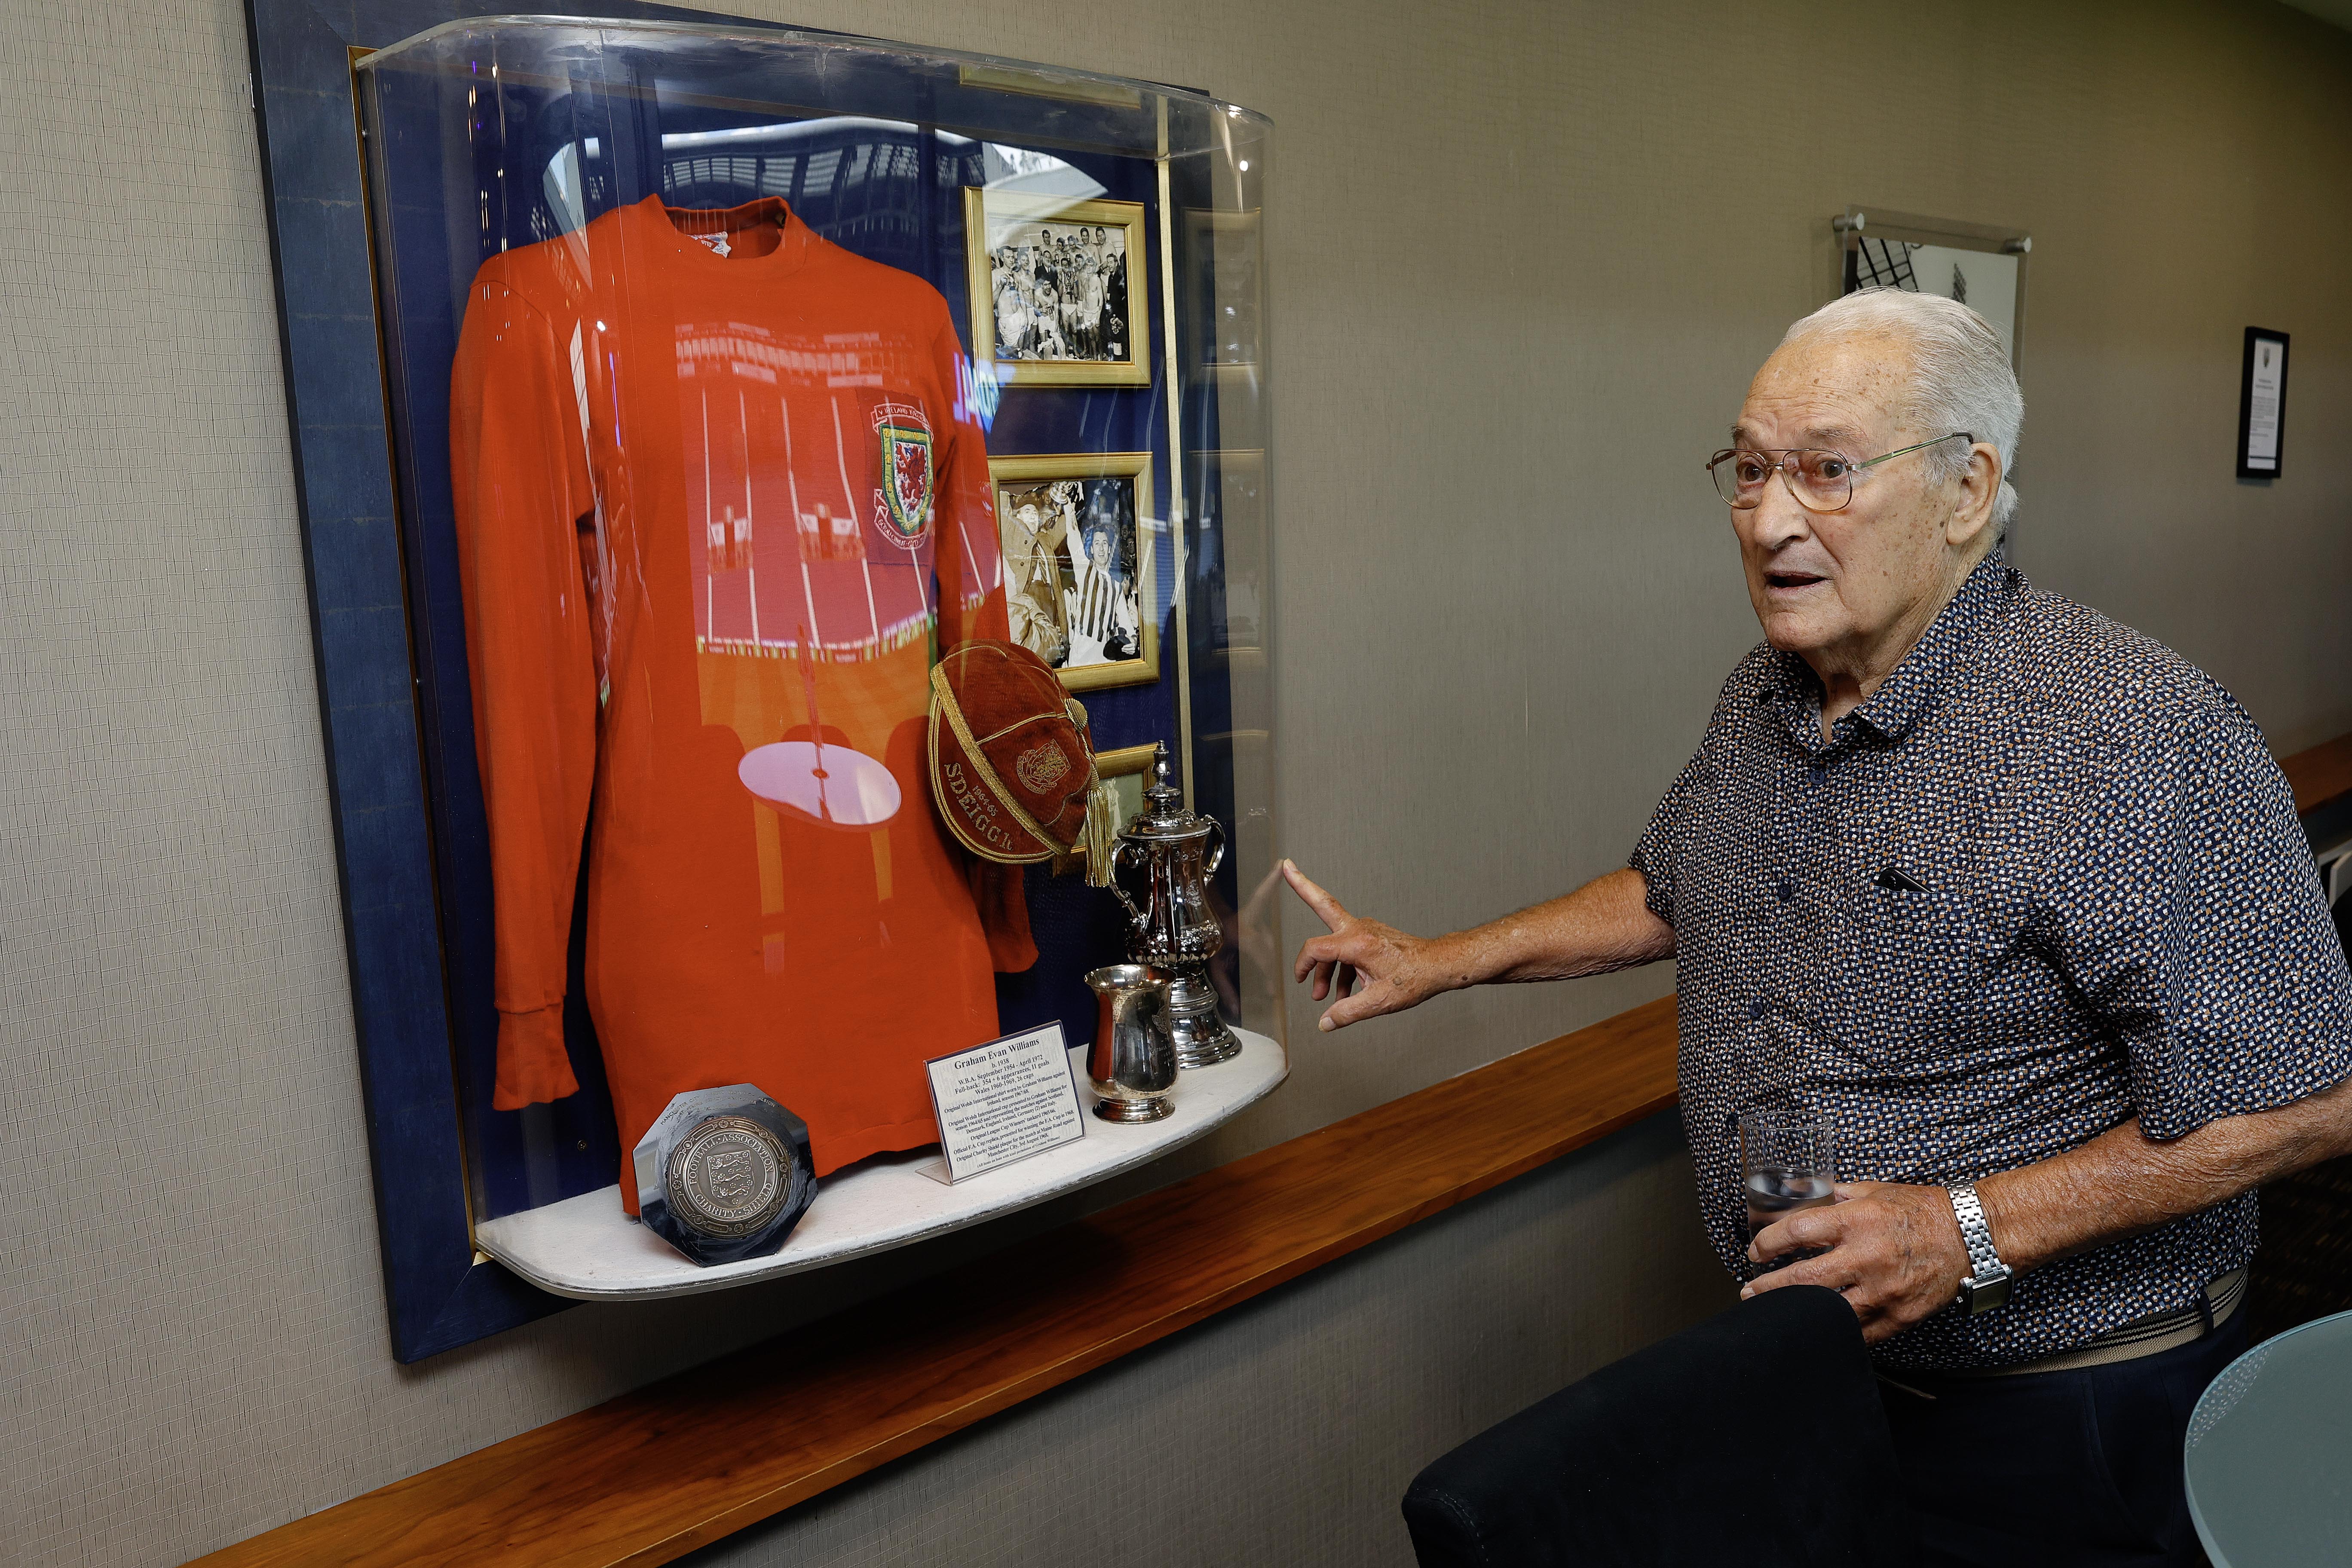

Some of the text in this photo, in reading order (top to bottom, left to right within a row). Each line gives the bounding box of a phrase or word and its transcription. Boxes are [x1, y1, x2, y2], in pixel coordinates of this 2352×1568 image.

[885, 407, 908, 415] IRELAND
[954, 1038, 1039, 1069] Graham Evan Williams
[997, 1057, 1009, 1066] 1938
[955, 1082, 980, 1094] Full-back:
[982, 1078, 991, 1086] 354
[1000, 1067, 1031, 1080] appearances,
[1037, 1060, 1050, 1069] goals
[958, 1076, 976, 1085] W.B.A.
[977, 1068, 1003, 1080] September
[1004, 1063, 1015, 1071] 1954
[1019, 1058, 1031, 1067] April
[1032, 1054, 1043, 1062] 1972
[990, 1078, 1017, 1090] 1960-1969,
[758, 1097, 776, 1107] ALBION
[944, 1104, 961, 1114] Original
[972, 1092, 997, 1104] International
[1022, 1080, 1037, 1088] Graham
[1053, 1070, 1065, 1078] against
[948, 1117, 965, 1127] Original
[977, 1105, 1001, 1118] International
[1008, 1097, 1027, 1108] presented
[1030, 1091, 1046, 1099] Graham
[968, 1118, 983, 1127] 1964/65
[991, 1109, 1014, 1120] representing
[1020, 1101, 1035, 1109] matches
[1035, 1096, 1048, 1105] against
[1017, 1108, 1034, 1117] Germany
[953, 1145, 968, 1155] Official
[999, 1129, 1017, 1140] presented
[956, 1152, 973, 1162] Original
[972, 1148, 987, 1156] Charity
[987, 1143, 1000, 1151] Shield
[999, 1139, 1012, 1148] plaque
[1062, 1117, 1075, 1125] against
[970, 1131, 987, 1141] Original
[1026, 1112, 1041, 1122] tankard
[689, 1133, 774, 1185] FOOTBALL ASSOCIATION
[987, 1147, 1009, 1158] Manchester
[1026, 1136, 1039, 1145] August
[695, 1182, 772, 1217] CHARITY SHIELD
